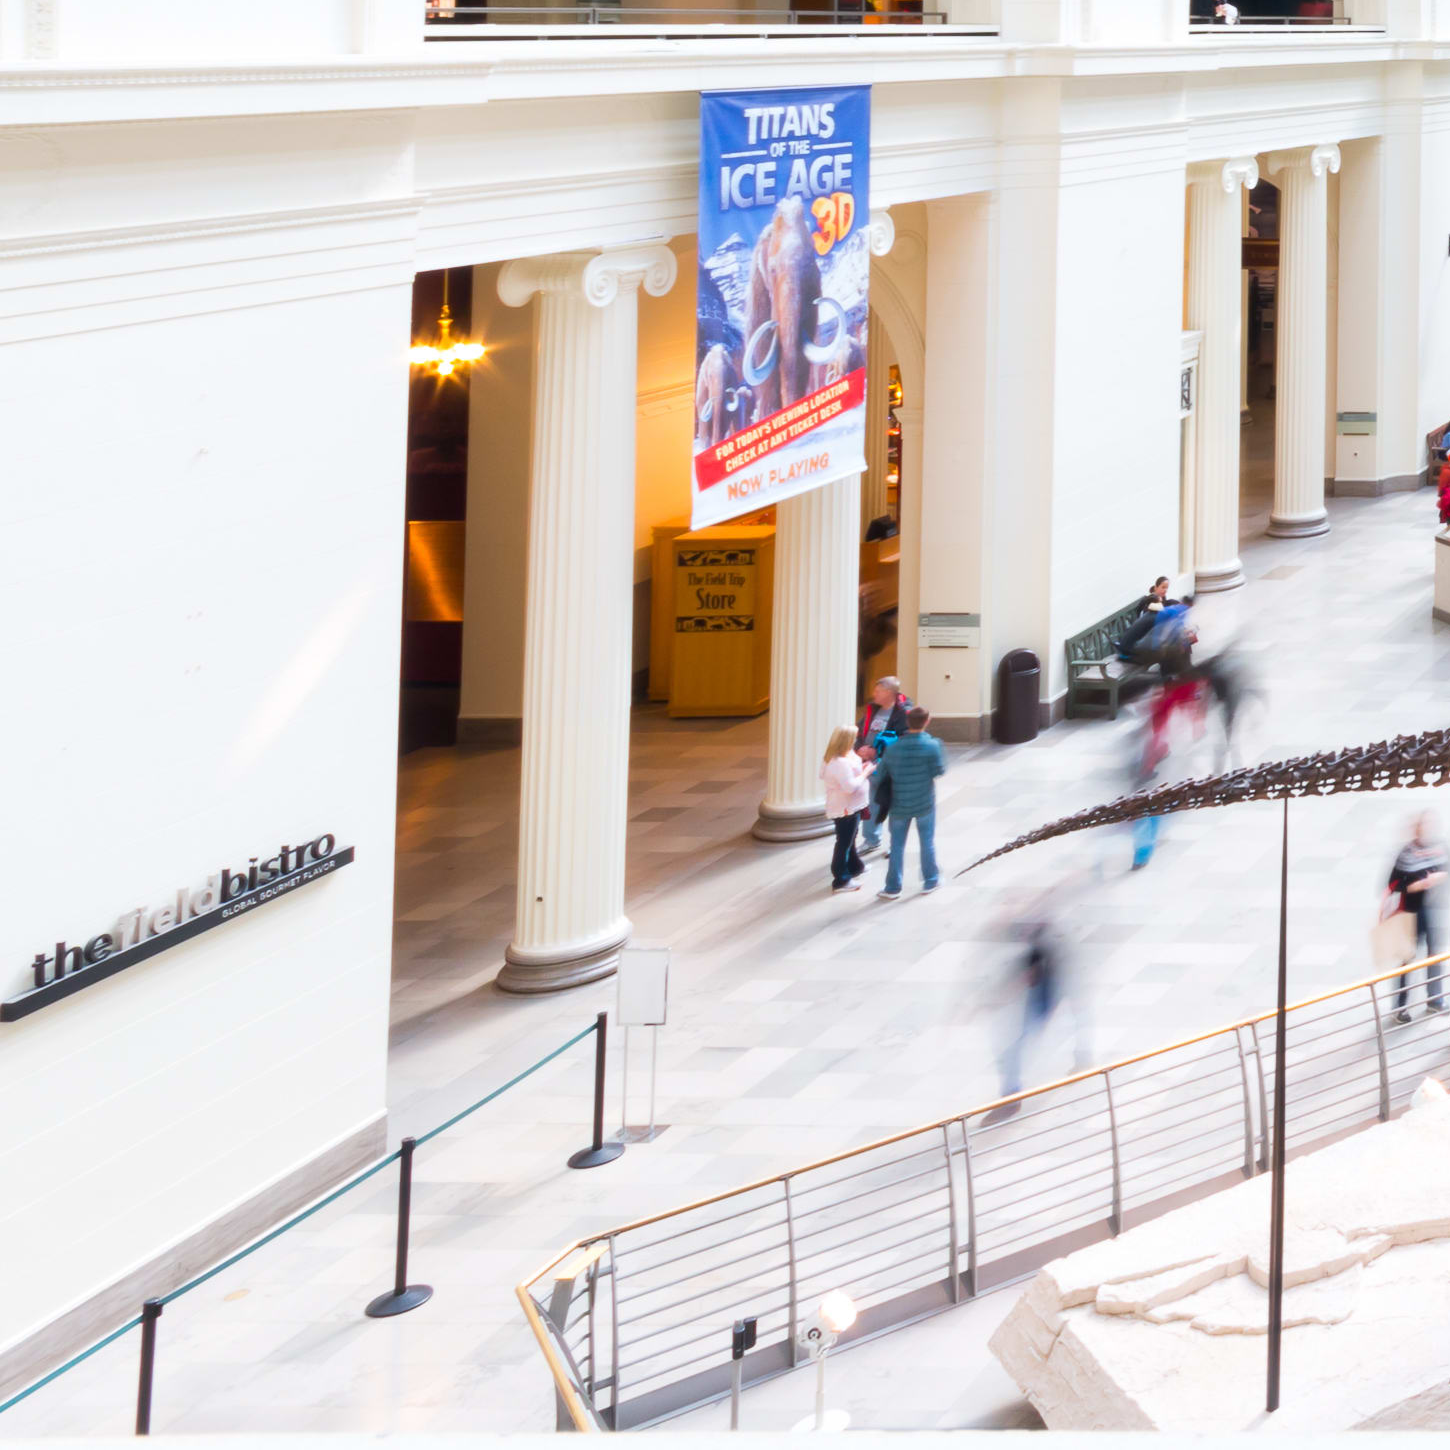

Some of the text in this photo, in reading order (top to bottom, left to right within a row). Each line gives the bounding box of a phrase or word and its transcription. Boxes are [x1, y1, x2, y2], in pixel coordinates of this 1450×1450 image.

[744, 102, 836, 145] TITANS
[769, 139, 811, 158] OF THE
[720, 153, 853, 211] ICE AGE
[811, 191, 855, 256] 3D
[715, 380, 849, 461] FOR TODAY'S VIEWING LOCATION
[725, 400, 843, 473] CHECK AT ANY TICKET DESK
[727, 452, 829, 501] NOW PLAYING
[688, 572, 745, 588] The Field Trip
[696, 587, 736, 611] Store
[222, 860, 336, 918] GLOBAL GOURMET FLAVOR
